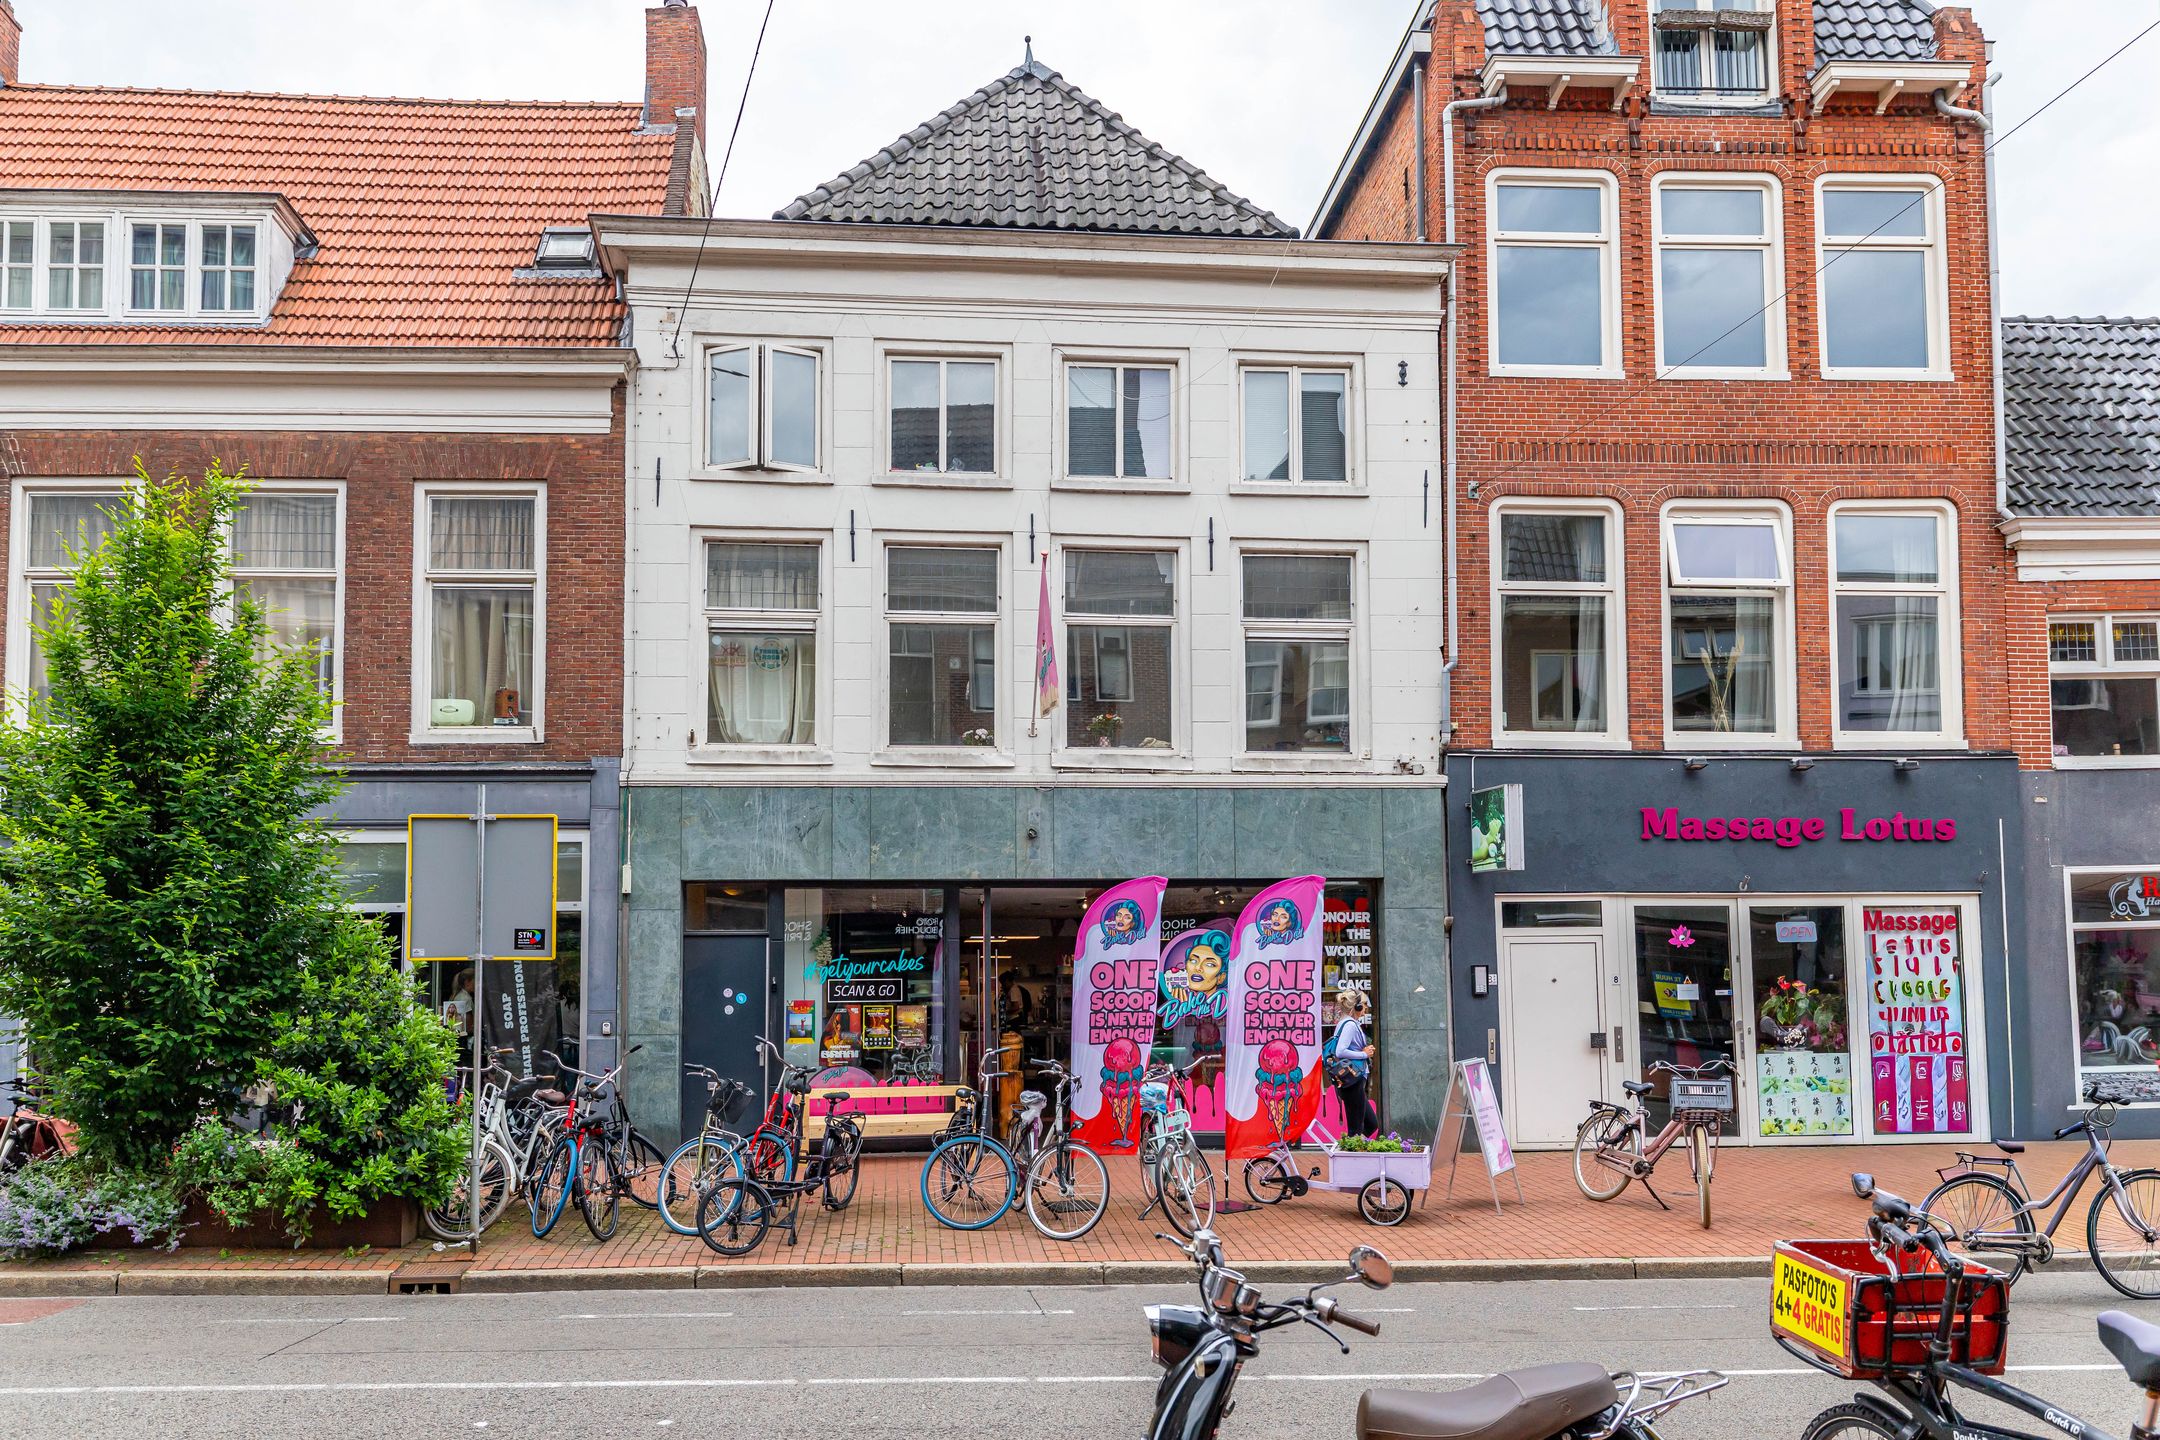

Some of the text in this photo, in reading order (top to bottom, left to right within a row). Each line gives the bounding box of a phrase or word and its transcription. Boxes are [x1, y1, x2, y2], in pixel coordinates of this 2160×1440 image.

[1640, 807, 1957, 848] Massage Lotus
[1321, 911, 1370, 923] ONQUER
[1863, 910, 1957, 936] Massage
[518, 931, 533, 939] STN
[1346, 928, 1371, 940] THE
[1780, 926, 1812, 937] OPEN
[1324, 945, 1371, 957] WORLD
[803, 949, 924, 985] #getyourcakes
[1090, 959, 1158, 991] ONE
[1244, 959, 1316, 991] ONE
[1345, 962, 1371, 974] ONE
[833, 984, 896, 997] SCAN & GO
[1337, 979, 1371, 991] CAKE
[1613, 976, 1619, 984] 8
[502, 993, 514, 1029] SOAP
[514, 960, 530, 1042] PROFESSION
[1090, 990, 1156, 1012] SCOOP
[1156, 991, 1206, 1028] Bake
[1244, 990, 1315, 1013] SCOOP
[1089, 1011, 1155, 1029] IS NEVER
[1244, 1012, 1316, 1029] IS NEVER
[1244, 1028, 1316, 1046] ENOUGH
[522, 1044, 533, 1079] HAIR
[1782, 1262, 1837, 1310] PASFOTO'S
[1775, 1289, 1841, 1345] 4+4 GRATIS
[2046, 1411, 2080, 1434] Dutch ID
